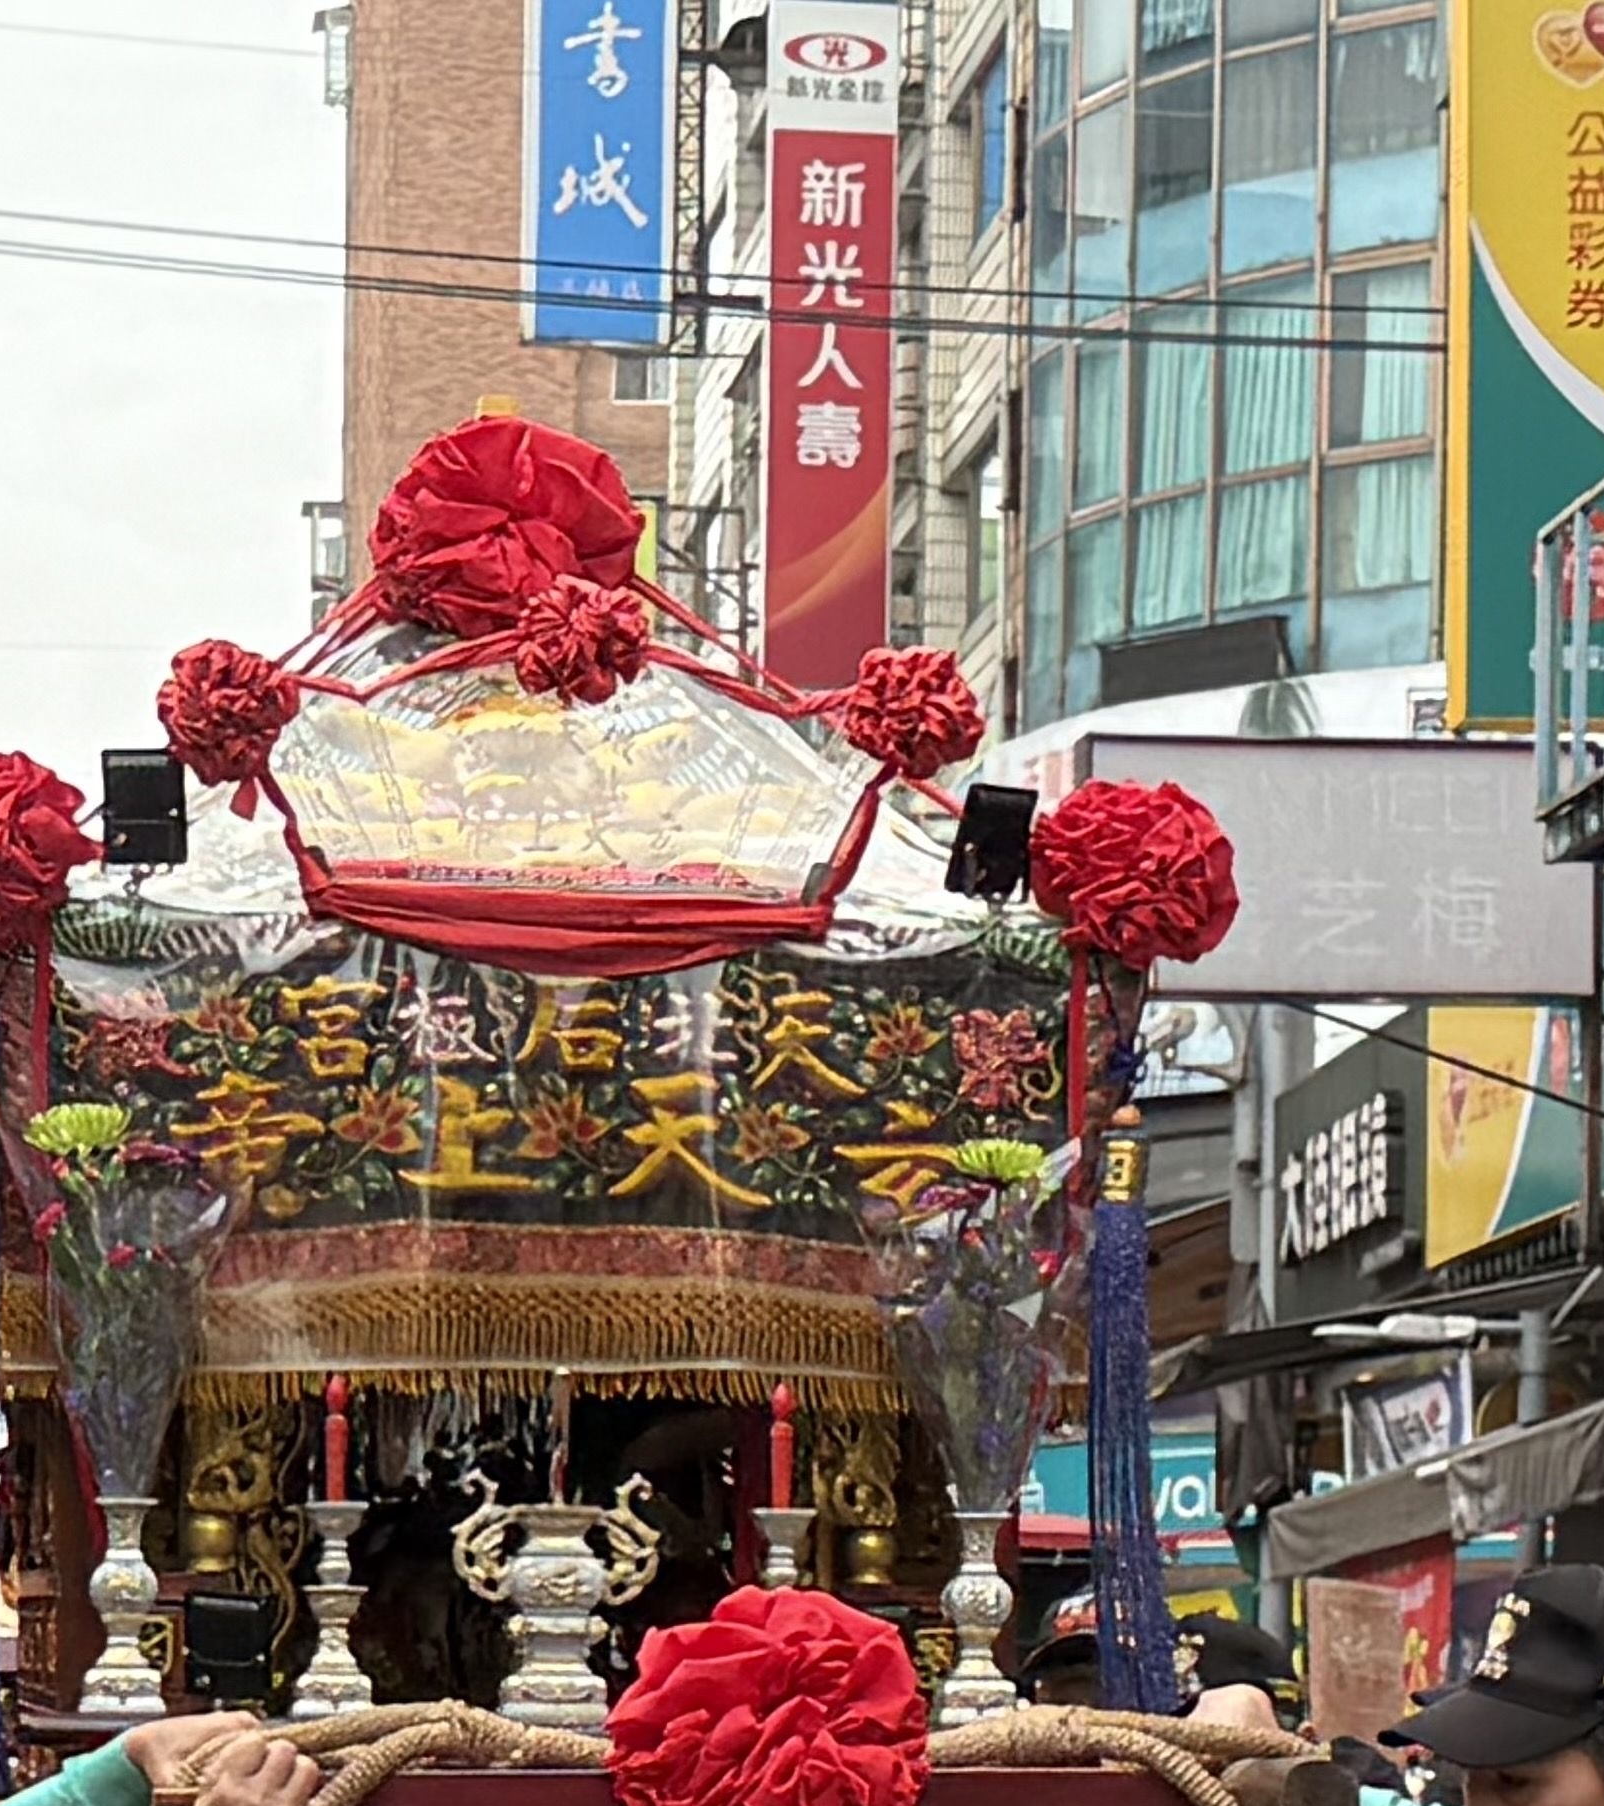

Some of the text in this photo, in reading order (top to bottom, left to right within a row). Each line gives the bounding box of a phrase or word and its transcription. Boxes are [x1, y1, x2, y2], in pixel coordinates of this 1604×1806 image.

[554, 8, 648, 228] 書城
[796, 160, 867, 469] 新光人壽
